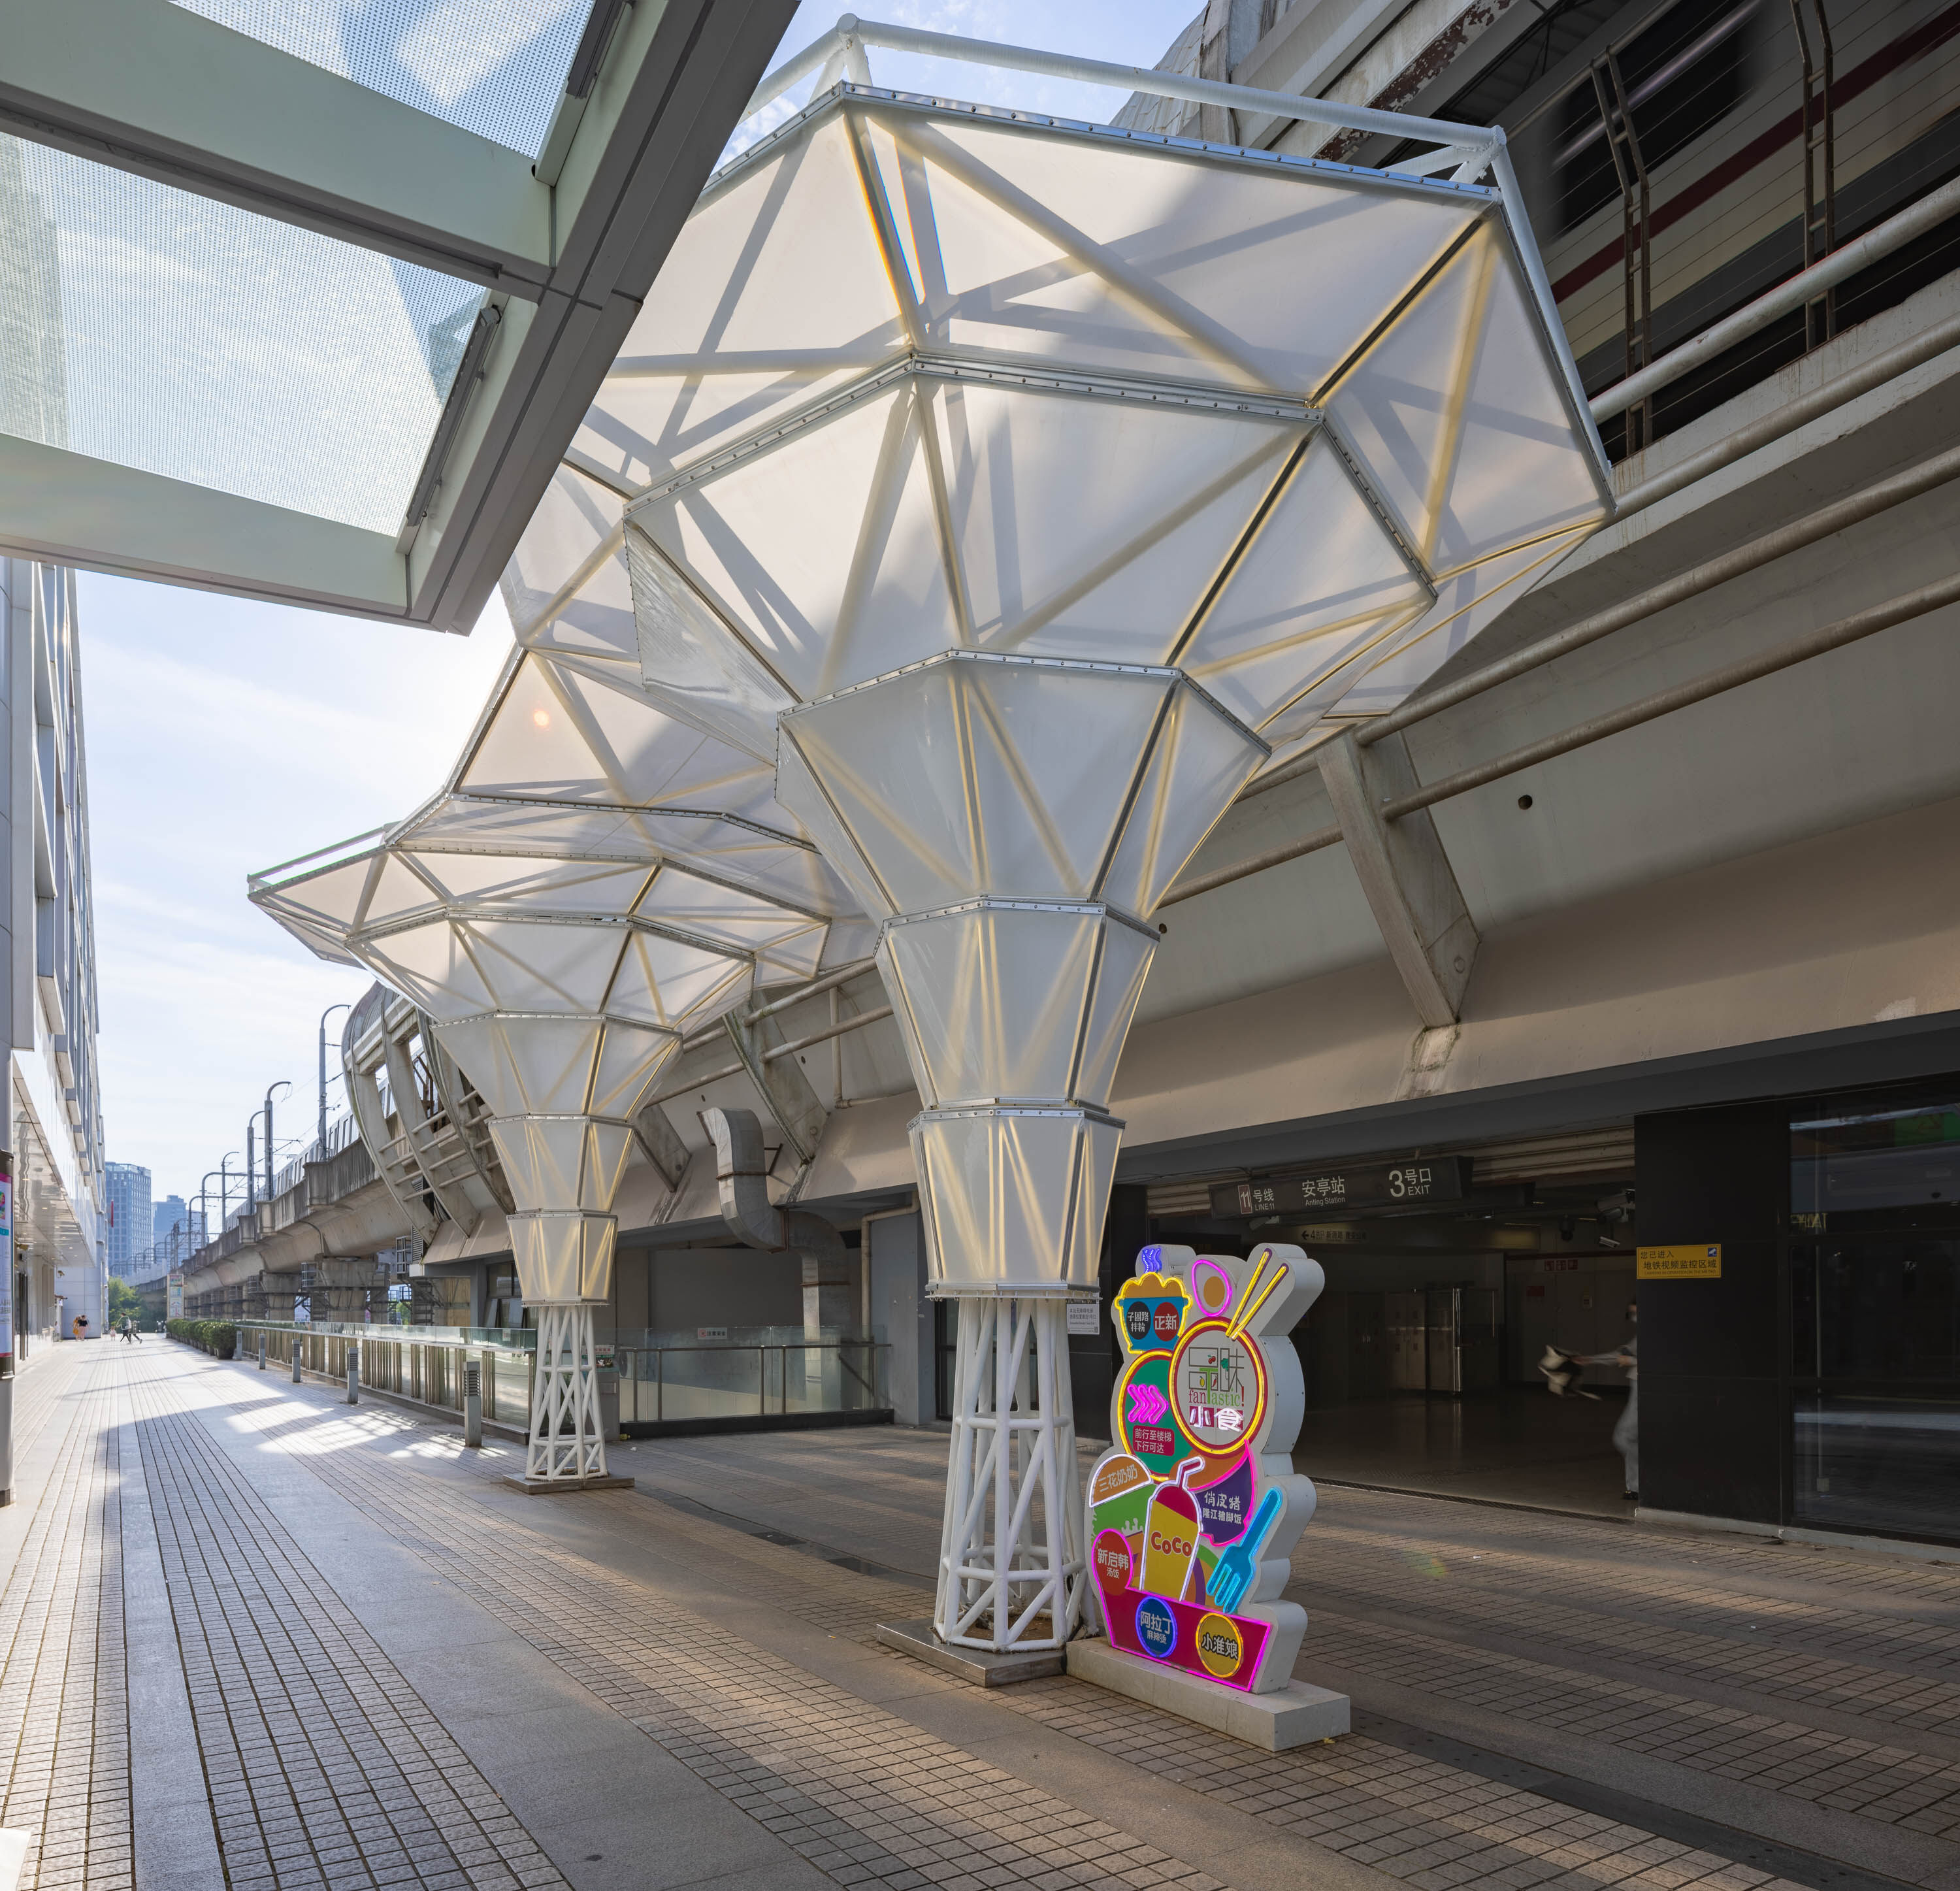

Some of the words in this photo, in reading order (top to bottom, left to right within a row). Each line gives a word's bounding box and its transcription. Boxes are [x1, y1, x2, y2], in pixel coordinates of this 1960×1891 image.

[1301, 1176, 1345, 1198] 安亭站
[1407, 1185, 1431, 1196] EXIT
[1305, 1198, 1324, 1208] Anting
[1324, 1196, 1346, 1206] Station
[1644, 1259, 1717, 1270] 地铁视频监控区域
[1128, 1311, 1149, 1322] 子固路
[1154, 1313, 1177, 1330] 正新
[1131, 1323, 1145, 1332] 拌粉
[1189, 1406, 1244, 1432] 小食
[1135, 1427, 1171, 1442] 前行至楼梯
[1135, 1440, 1164, 1454] 下行可达
[1098, 1464, 1138, 1492] 三花奶奶
[1204, 1490, 1241, 1511] 俏皮猪
[1203, 1507, 1242, 1524] 隆江猪脚饭
[1098, 1548, 1129, 1571] 新启韩
[1107, 1567, 1119, 1579] 汤饭
[1140, 1611, 1171, 1635] 阿拉丁
[1147, 1630, 1168, 1645] 麻辣烫
[1201, 1632, 1239, 1660] 小淮娘
